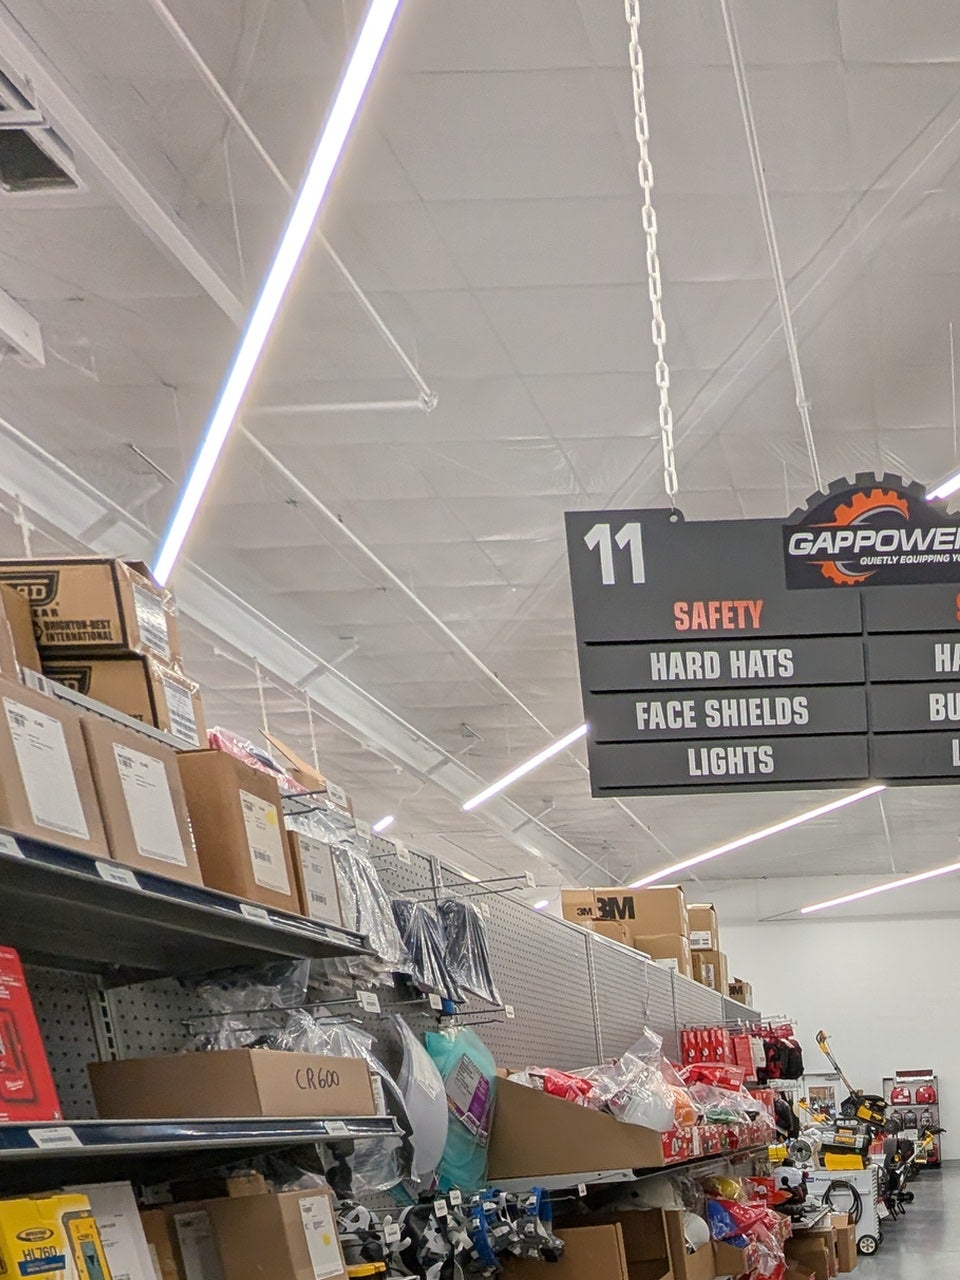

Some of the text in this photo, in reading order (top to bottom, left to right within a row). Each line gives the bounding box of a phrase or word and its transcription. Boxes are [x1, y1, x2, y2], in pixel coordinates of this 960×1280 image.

[584, 522, 645, 586] 11
[860, 556, 899, 566] QUIETLY
[900, 554, 950, 564] EQUIPPING
[44, 619, 111, 631] BRIGHTON-BEST
[674, 600, 763, 631] SAFETY
[46, 631, 113, 642] INTERNATIONAL
[650, 648, 794, 681] HARD HATS
[635, 696, 809, 731] FACE SHIELDS
[687, 745, 774, 776] LIGHTS
[576, 907, 593, 916] 3M
[597, 896, 636, 920] 3M
[729, 985, 743, 996] 3M
